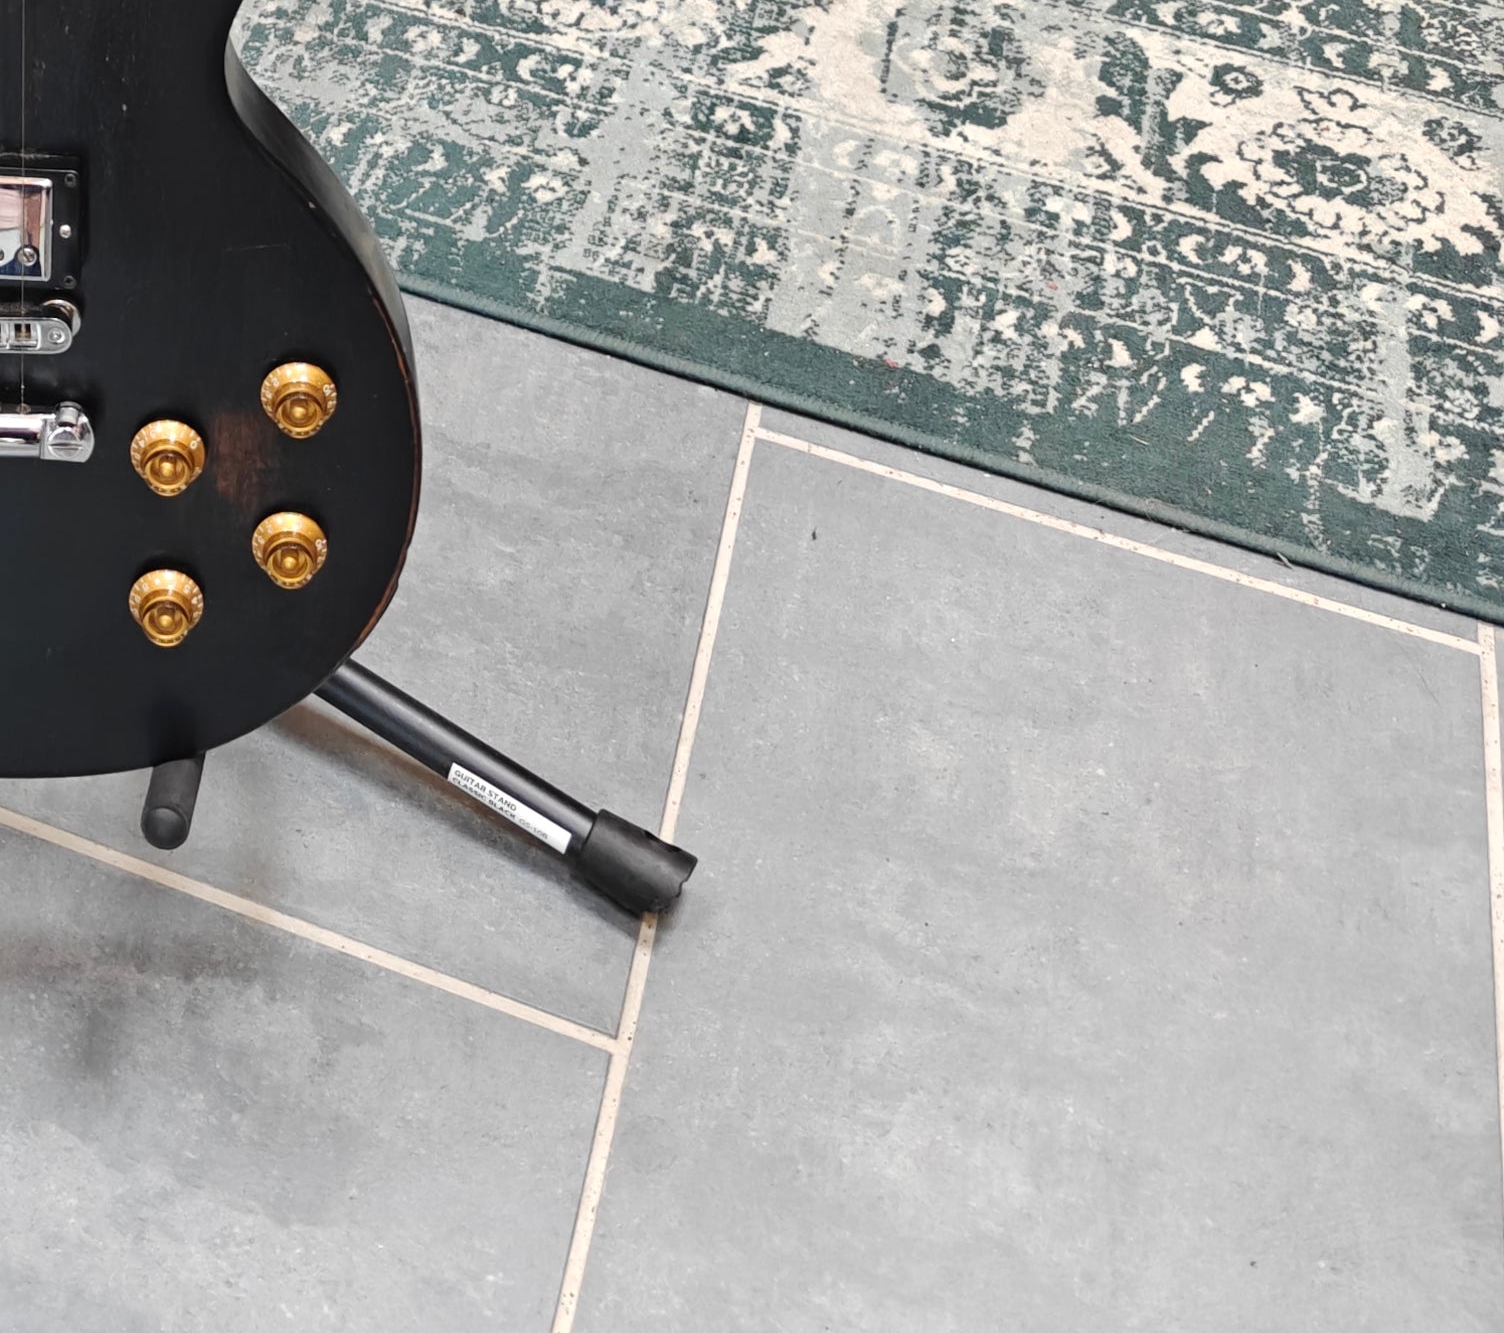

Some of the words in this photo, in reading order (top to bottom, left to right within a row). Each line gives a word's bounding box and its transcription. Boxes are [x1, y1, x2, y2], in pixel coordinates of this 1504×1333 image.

[452, 777, 487, 800] CLASSIC
[488, 799, 516, 820] BLACK
[454, 769, 487, 793] GUITAR
[488, 790, 517, 812] STAND
